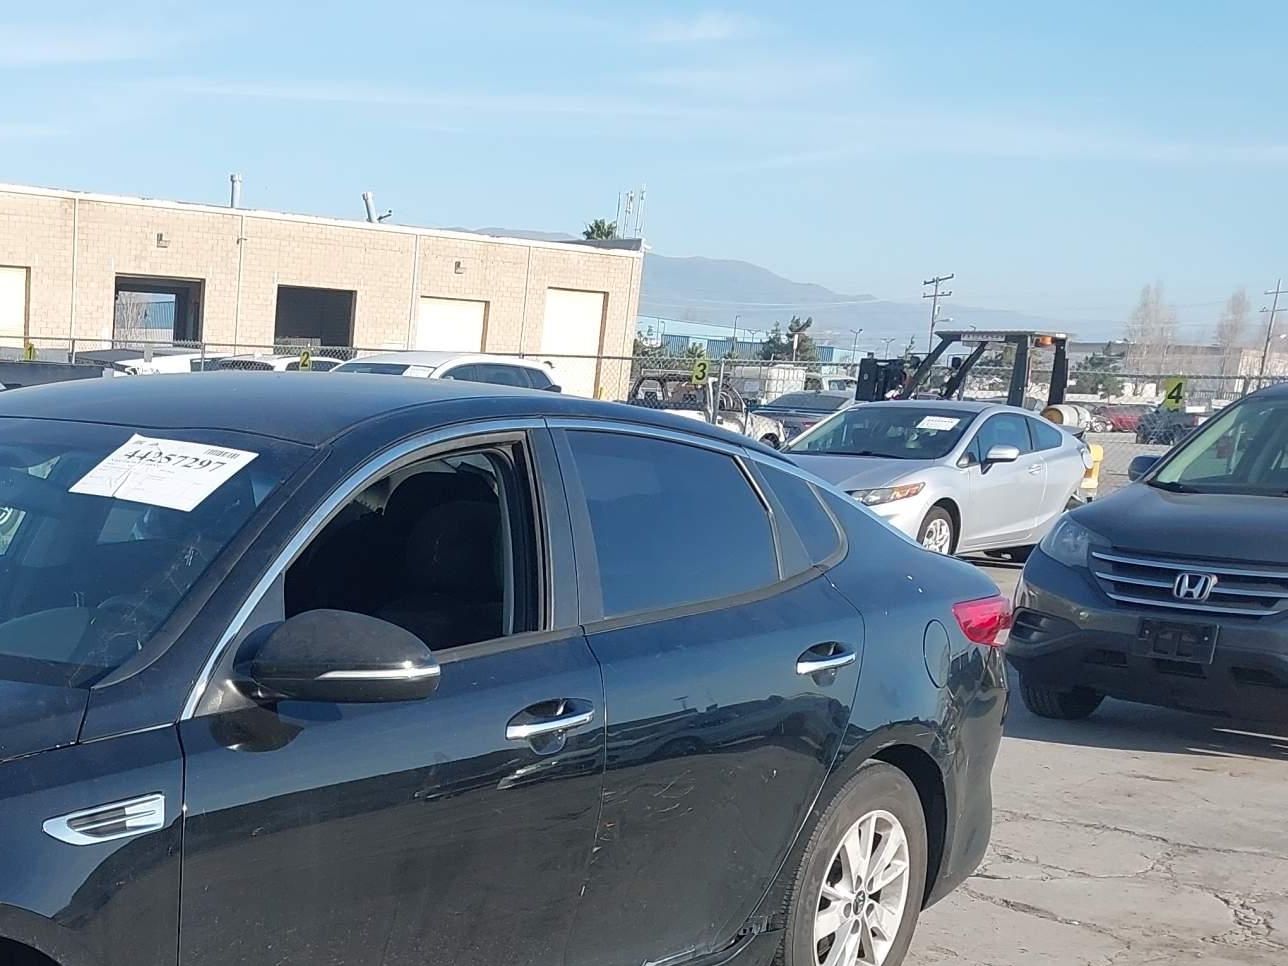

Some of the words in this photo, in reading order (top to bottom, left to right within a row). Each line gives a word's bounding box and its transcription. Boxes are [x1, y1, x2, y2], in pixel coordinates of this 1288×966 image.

[301, 351, 310, 367] 2
[695, 362, 707, 381] 3
[1168, 382, 1183, 404] 4
[123, 447, 228, 473] 44257297
